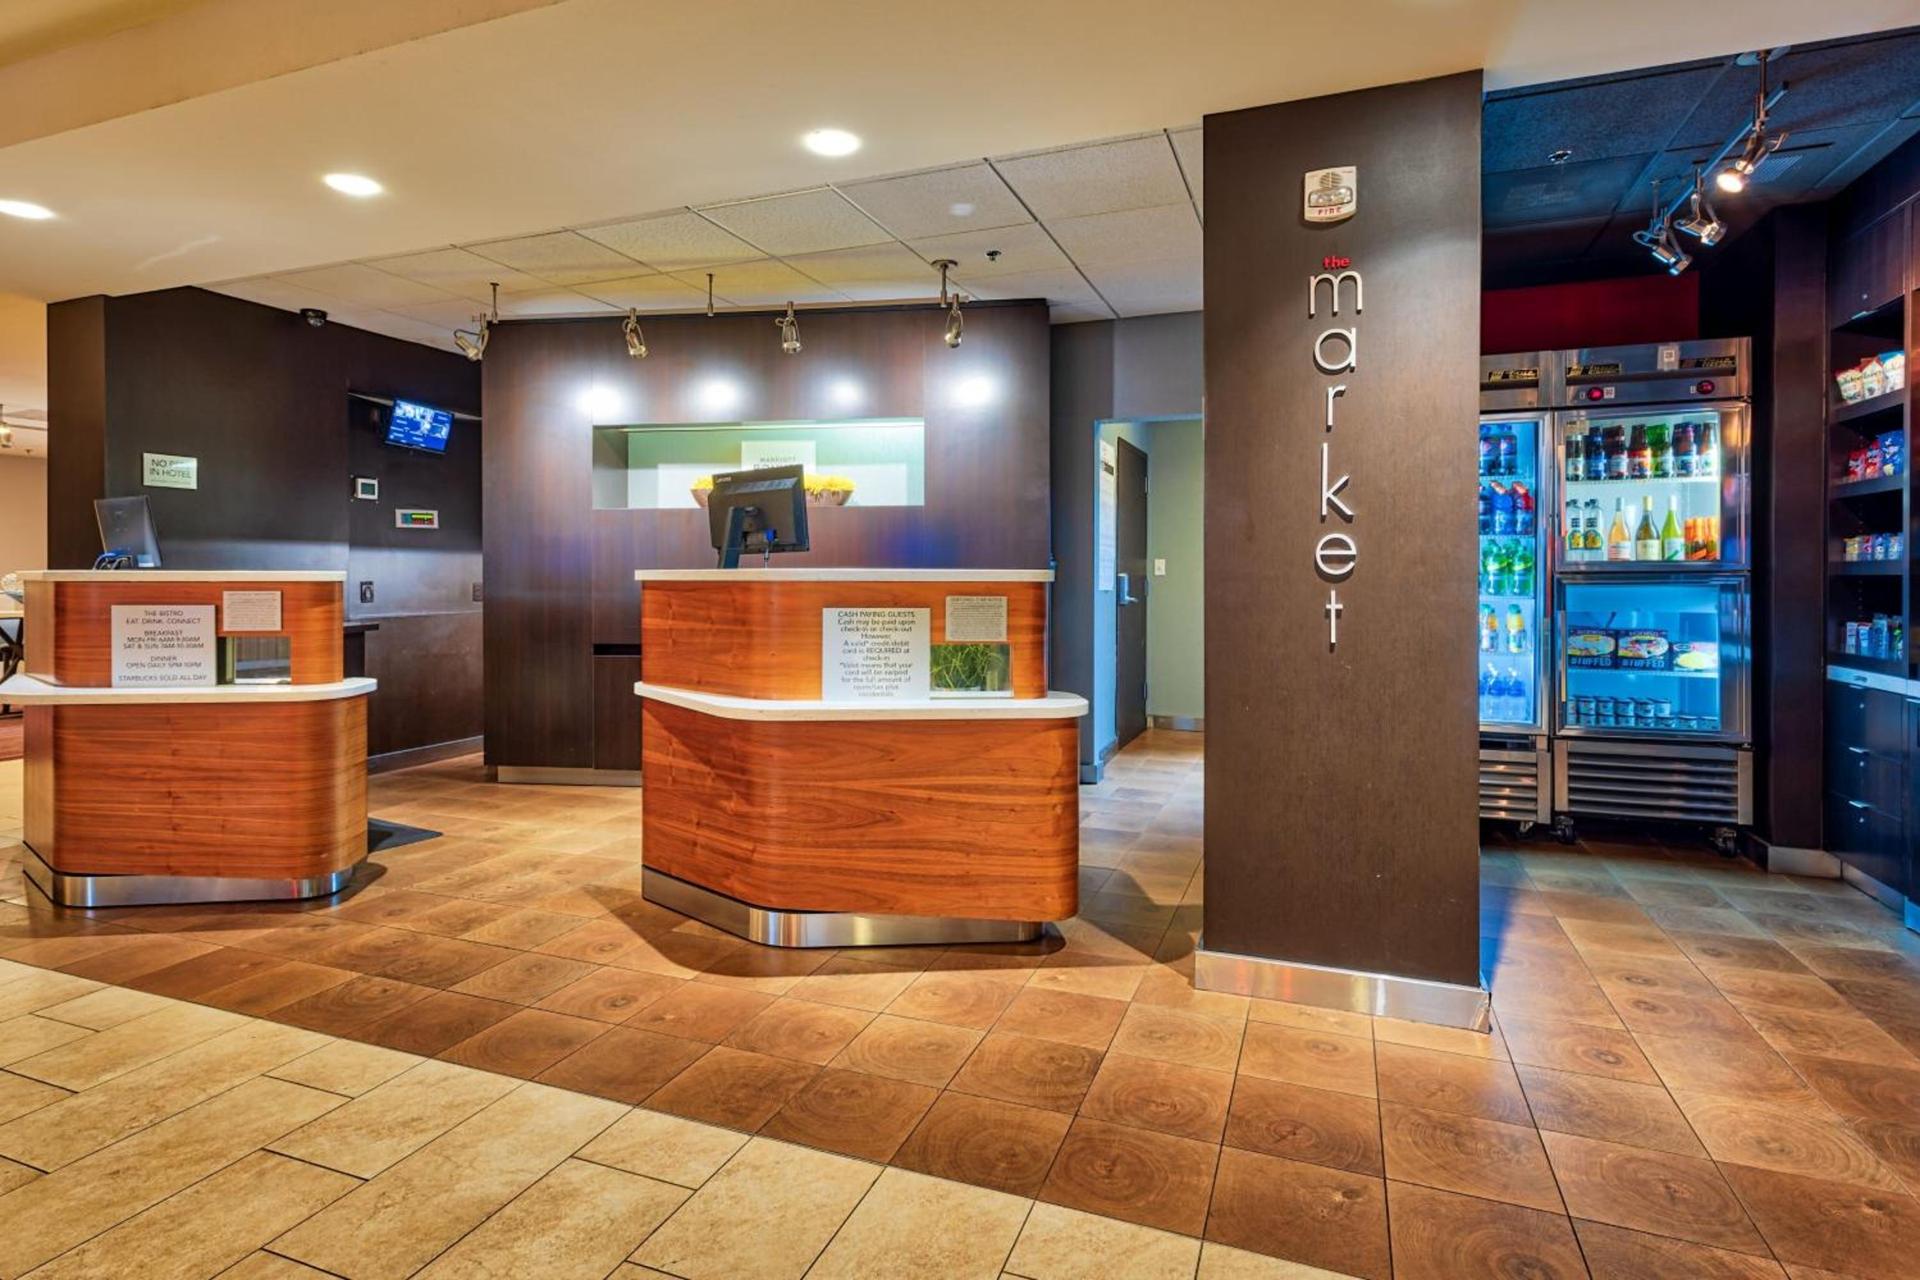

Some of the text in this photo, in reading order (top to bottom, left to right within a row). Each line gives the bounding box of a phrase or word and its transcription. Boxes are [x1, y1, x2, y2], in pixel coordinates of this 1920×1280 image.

[1318, 207, 1343, 215] FIRE
[1323, 256, 1351, 269] the
[151, 459, 167, 468] NO
[1308, 270, 1363, 648] market
[150, 468, 192, 479] IN HOTEL
